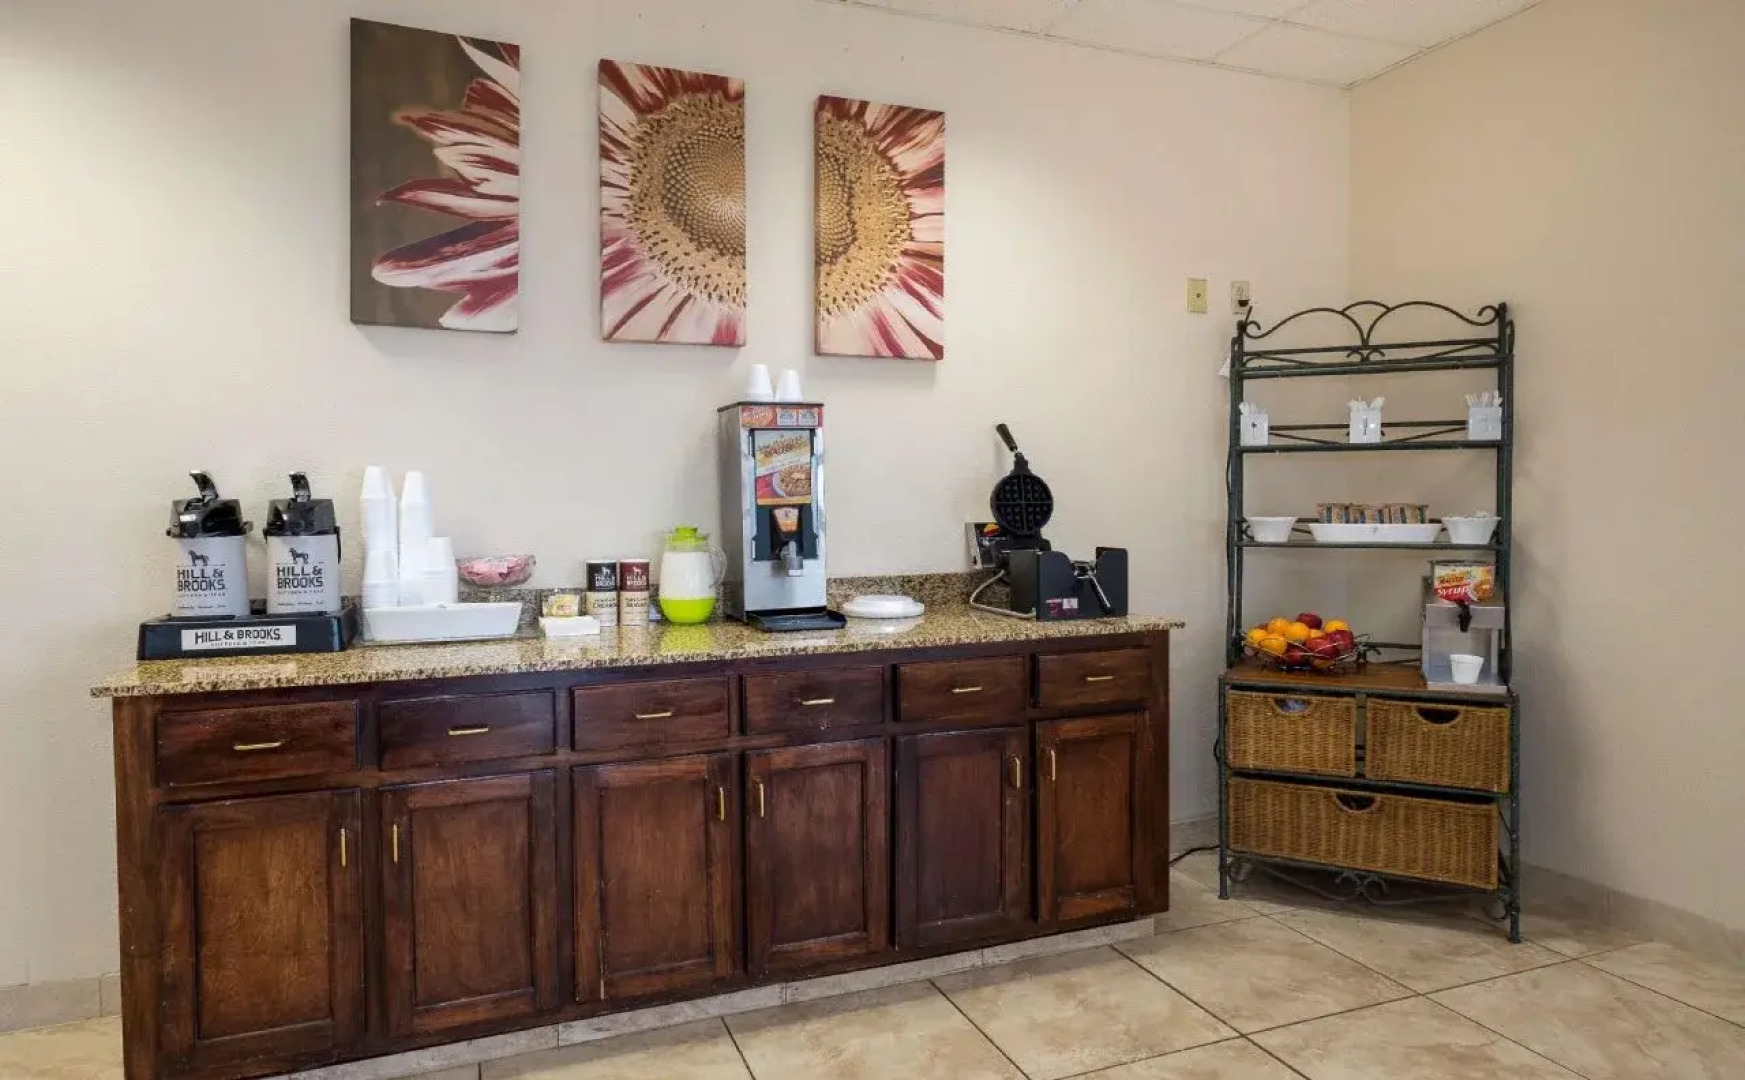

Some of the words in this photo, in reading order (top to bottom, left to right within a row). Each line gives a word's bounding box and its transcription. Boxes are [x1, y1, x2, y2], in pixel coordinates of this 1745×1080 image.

[177, 568, 210, 579] HILL
[213, 568, 223, 579] &
[277, 566, 310, 577] HILL
[312, 565, 323, 576] &
[177, 579, 226, 591] BROOKS
[277, 576, 324, 589] BROOKS
[194, 631, 221, 644] HILL
[223, 630, 234, 640] &
[236, 628, 280, 640] BROOKS
